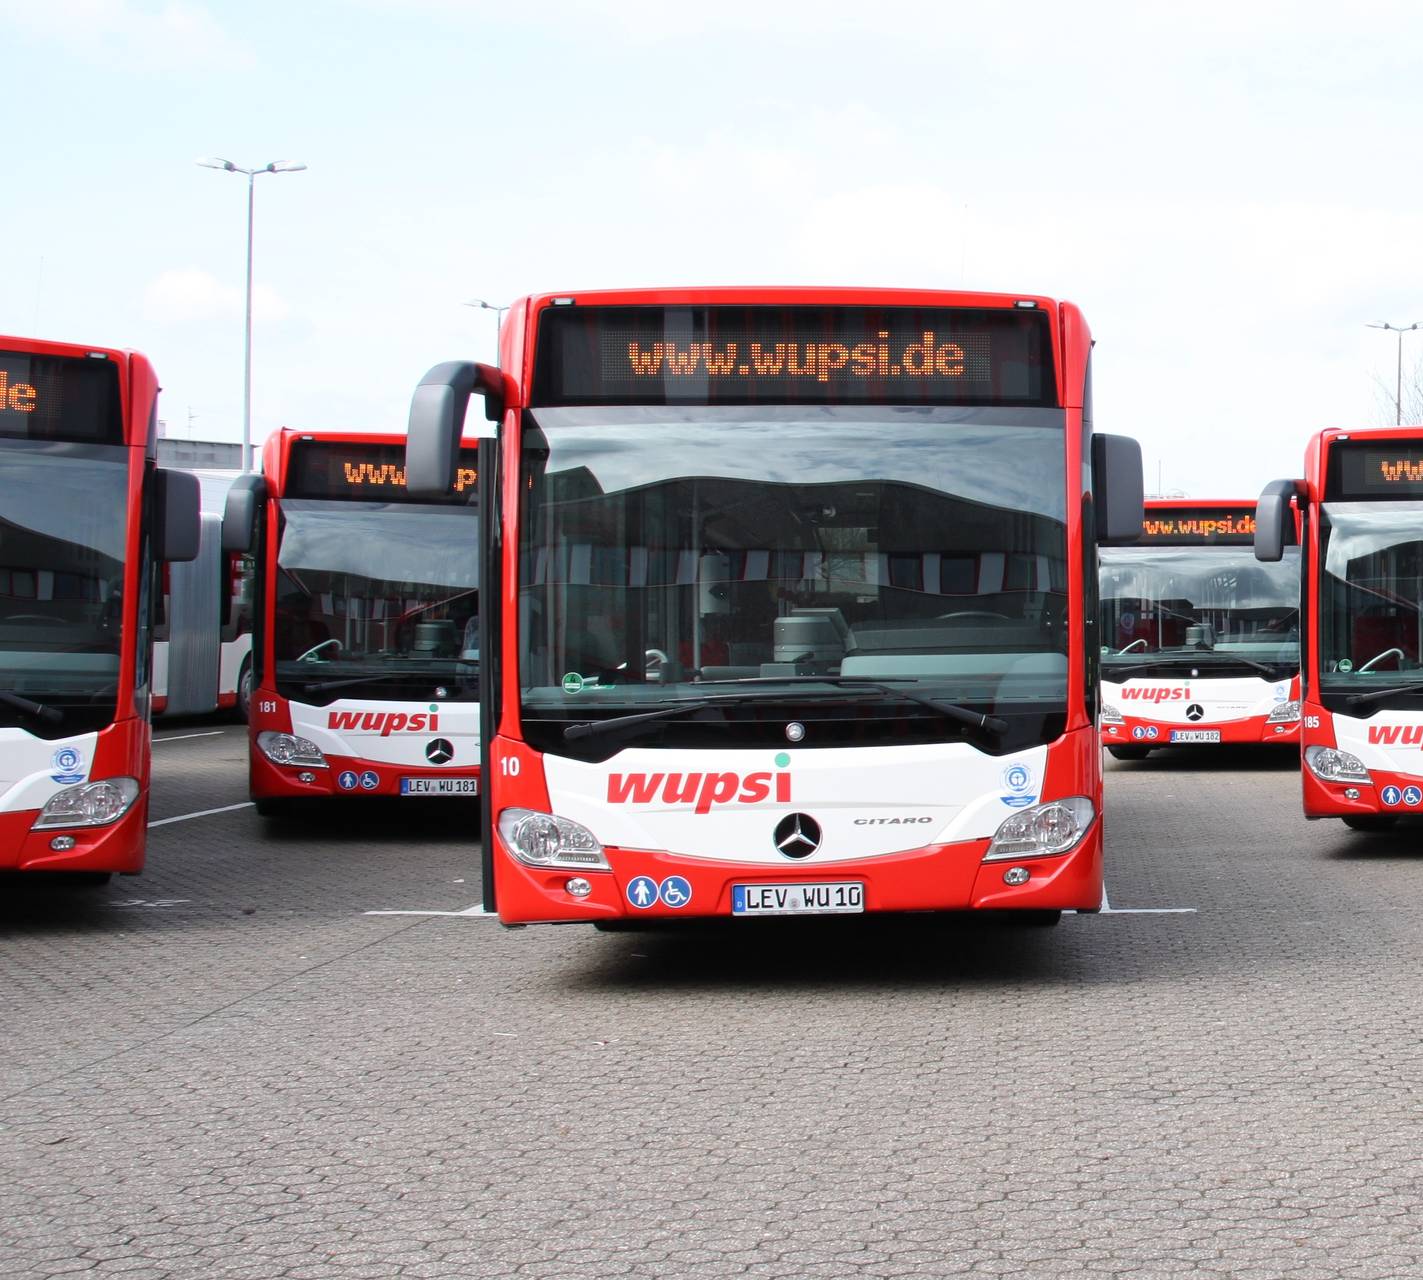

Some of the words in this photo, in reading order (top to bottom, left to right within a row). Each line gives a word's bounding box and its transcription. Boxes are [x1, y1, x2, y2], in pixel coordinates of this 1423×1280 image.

[628, 331, 964, 382] www.wupsi.de
[1121, 681, 1191, 704] wupsi
[259, 701, 277, 713] 181
[328, 703, 439, 737] wupsi
[1304, 715, 1320, 728] 185
[1175, 732, 1190, 741] LEV
[500, 756, 520, 777] 10
[409, 780, 431, 792] LEV
[439, 780, 453, 792] WU
[456, 780, 476, 792] 181
[607, 752, 792, 815] wupsi
[853, 816, 933, 825] CITARO
[746, 888, 788, 909] LEV
[803, 887, 830, 908] WU
[835, 886, 861, 907] 10
